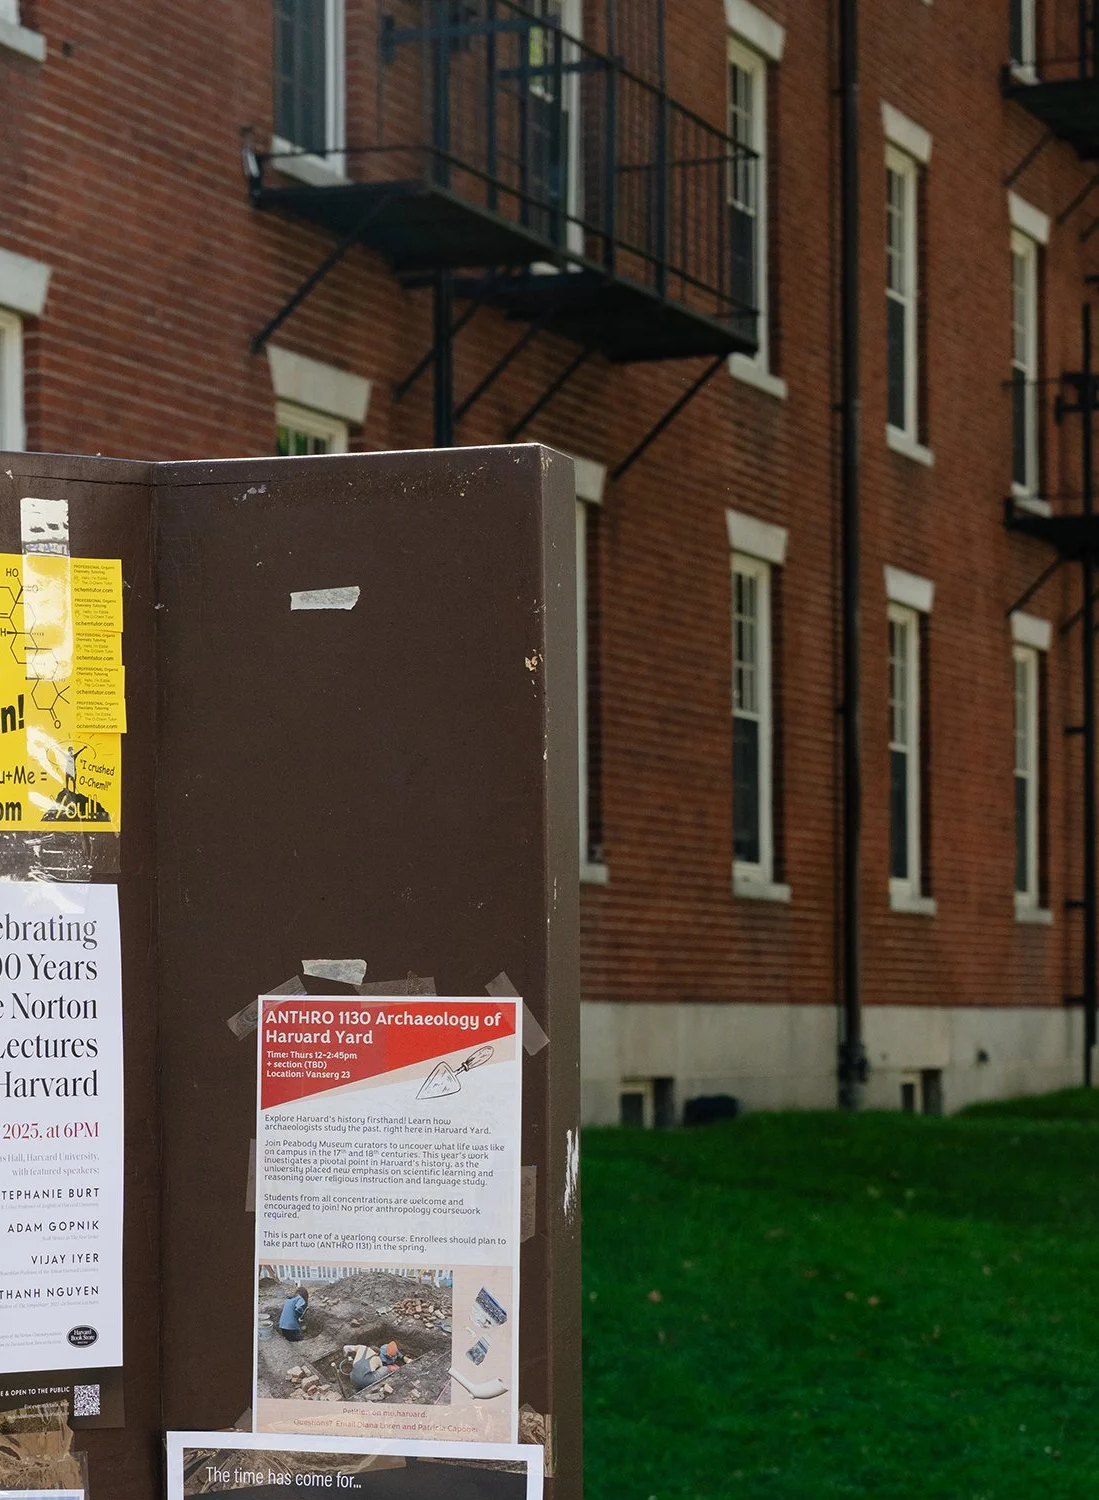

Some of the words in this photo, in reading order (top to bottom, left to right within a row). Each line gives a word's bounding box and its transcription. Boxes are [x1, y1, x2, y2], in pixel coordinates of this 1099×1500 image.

[26, 953, 98, 981] Years
[11, 992, 98, 1019] Norton
[265, 1010, 334, 1025] ANTHRO
[338, 1011, 371, 1025] 1130
[375, 1012, 479, 1030] Archaeology
[484, 1012, 501, 1026] of
[266, 1030, 331, 1044] Harvard
[335, 1030, 373, 1044] Yard
[267, 1051, 289, 1059] Time:
[290, 1051, 313, 1059] Thurs
[315, 1051, 357, 1061] 12-2:45pm
[266, 1070, 304, 1079] Location:
[306, 1070, 339, 1080] Vanserg
[265, 1115, 294, 1123] Explore
[296, 1115, 335, 1123] Harvard's
[337, 1115, 365, 1126] history
[367, 1116, 406, 1125] firsthand!
[408, 1117, 430, 1125] Learn
[433, 1117, 451, 1126] how
[3, 1122, 43, 1140] 2025,
[46, 1123, 60, 1138] at
[64, 1121, 99, 1138] 6PM
[68, 1188, 100, 1198] BURT
[7, 1222, 43, 1233] ADAM
[49, 1220, 99, 1232] GOPNIK
[31, 1255, 66, 1265] VIJAY
[72, 1254, 99, 1263] IYER
[47, 1286, 99, 1297] NGUYEN
[49, 1386, 70, 1394] PUBLIC
[206, 1467, 230, 1483] The
[234, 1469, 263, 1485] time
[268, 1469, 291, 1486] has
[296, 1472, 333, 1488] come
[336, 1472, 362, 1488] for...
